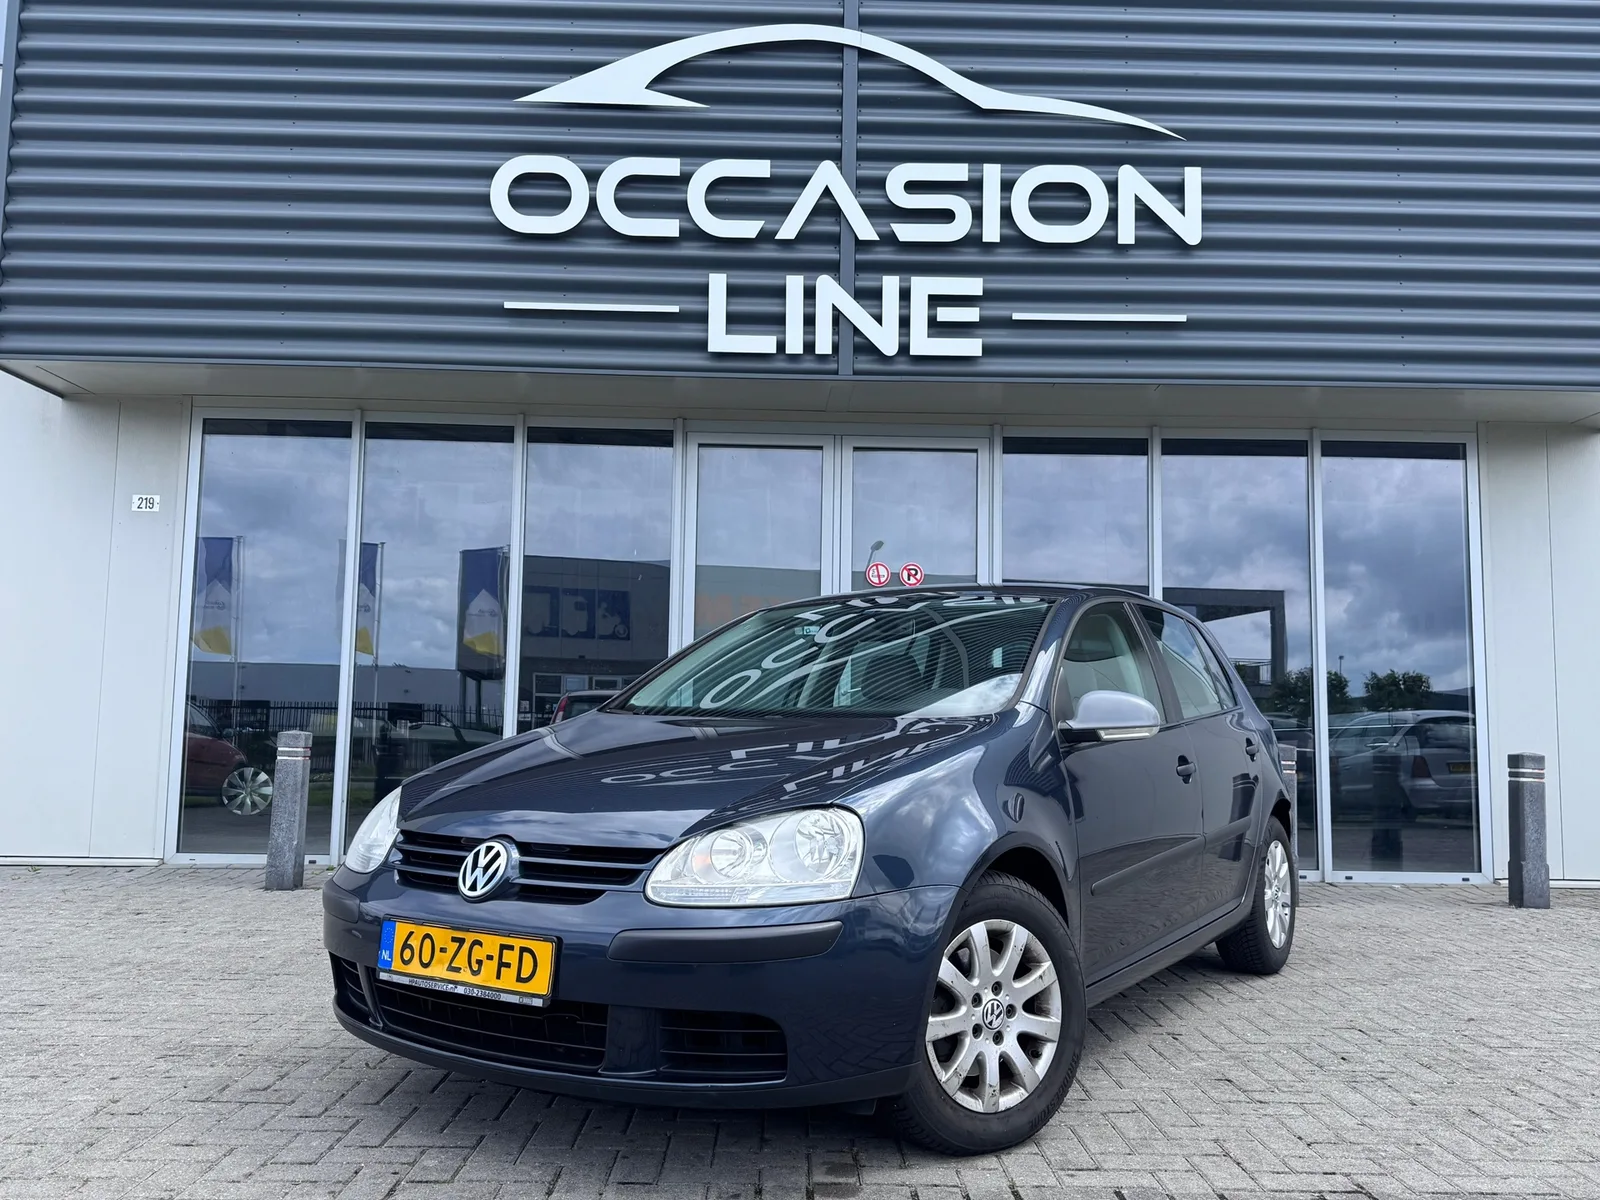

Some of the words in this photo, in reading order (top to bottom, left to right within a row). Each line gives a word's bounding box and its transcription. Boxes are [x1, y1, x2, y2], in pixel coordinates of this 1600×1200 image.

[490, 155, 1202, 246] OCCASION
[707, 273, 983, 357] LINE
[137, 496, 155, 510] 219
[381, 949, 392, 962] NL
[400, 930, 539, 984] 60-ZG-FD
